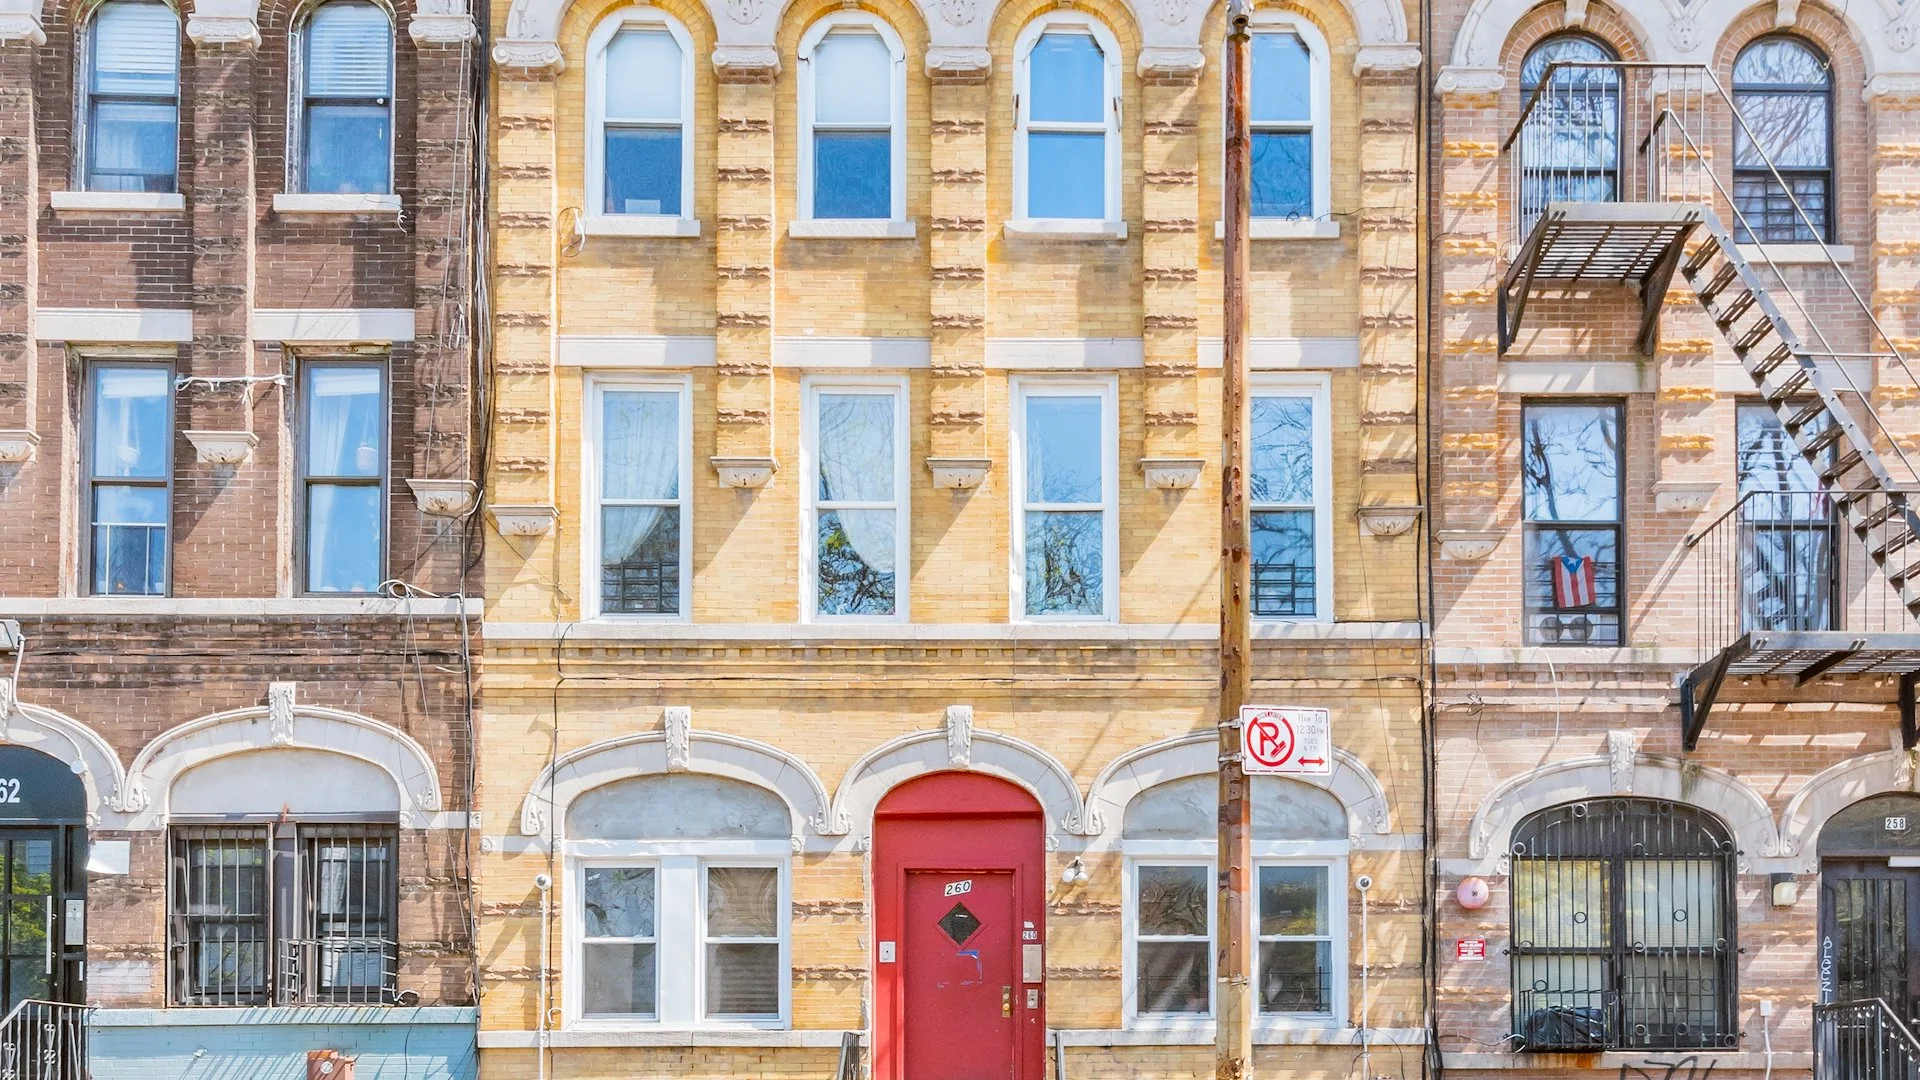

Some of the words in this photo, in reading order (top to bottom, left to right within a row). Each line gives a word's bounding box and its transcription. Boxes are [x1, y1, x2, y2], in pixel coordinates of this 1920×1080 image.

[1886, 818, 1904, 828] 258
[946, 881, 970, 894] 260
[1023, 931, 1037, 939] 260
